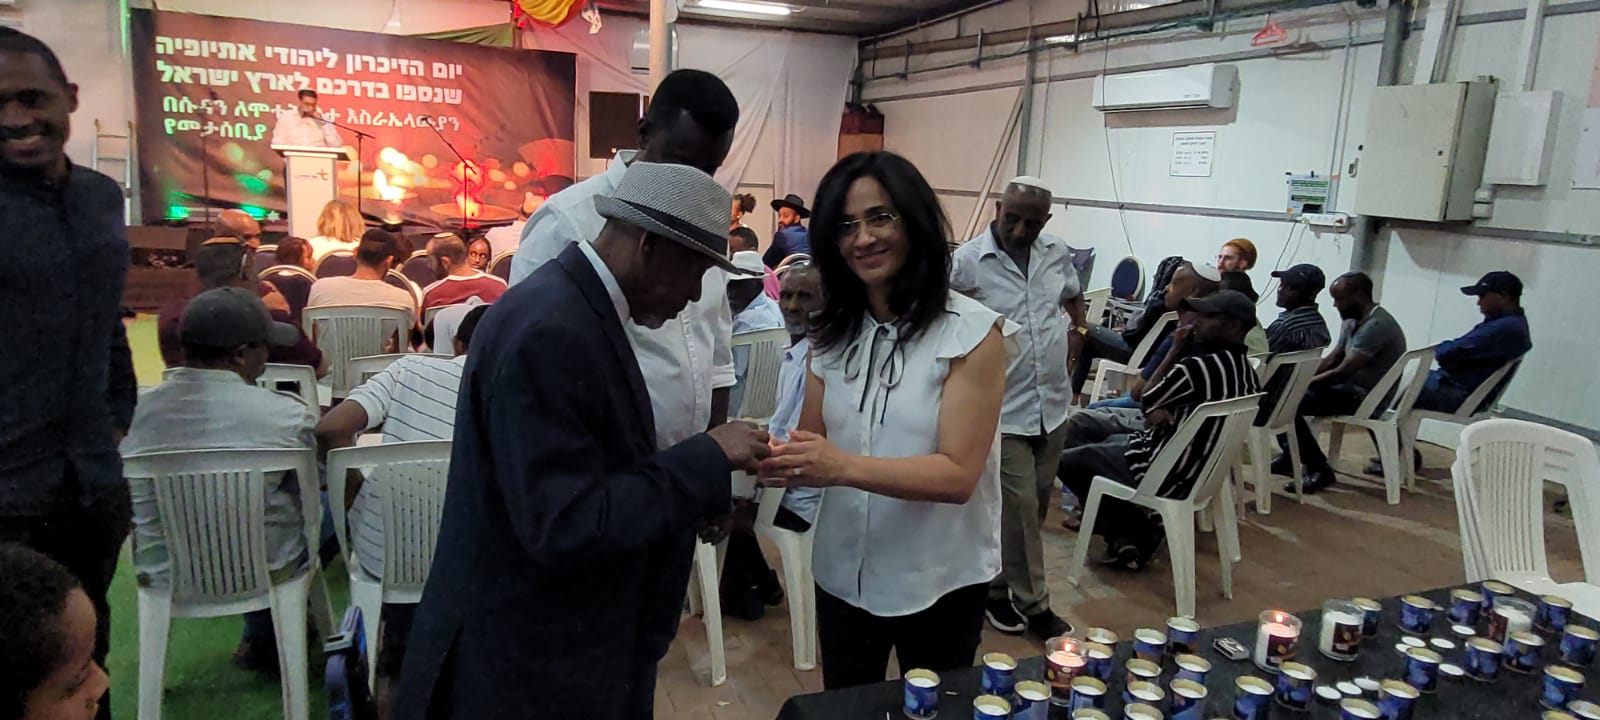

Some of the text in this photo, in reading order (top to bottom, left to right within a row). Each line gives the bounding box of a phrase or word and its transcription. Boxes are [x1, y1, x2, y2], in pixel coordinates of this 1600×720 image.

[155, 36, 463, 79] יום הזיכרון ליהודי אתיופיה
[155, 60, 463, 105] שנספו בדרכם לארץ ישראל
[163, 118, 268, 140] የመታሰቢያ
